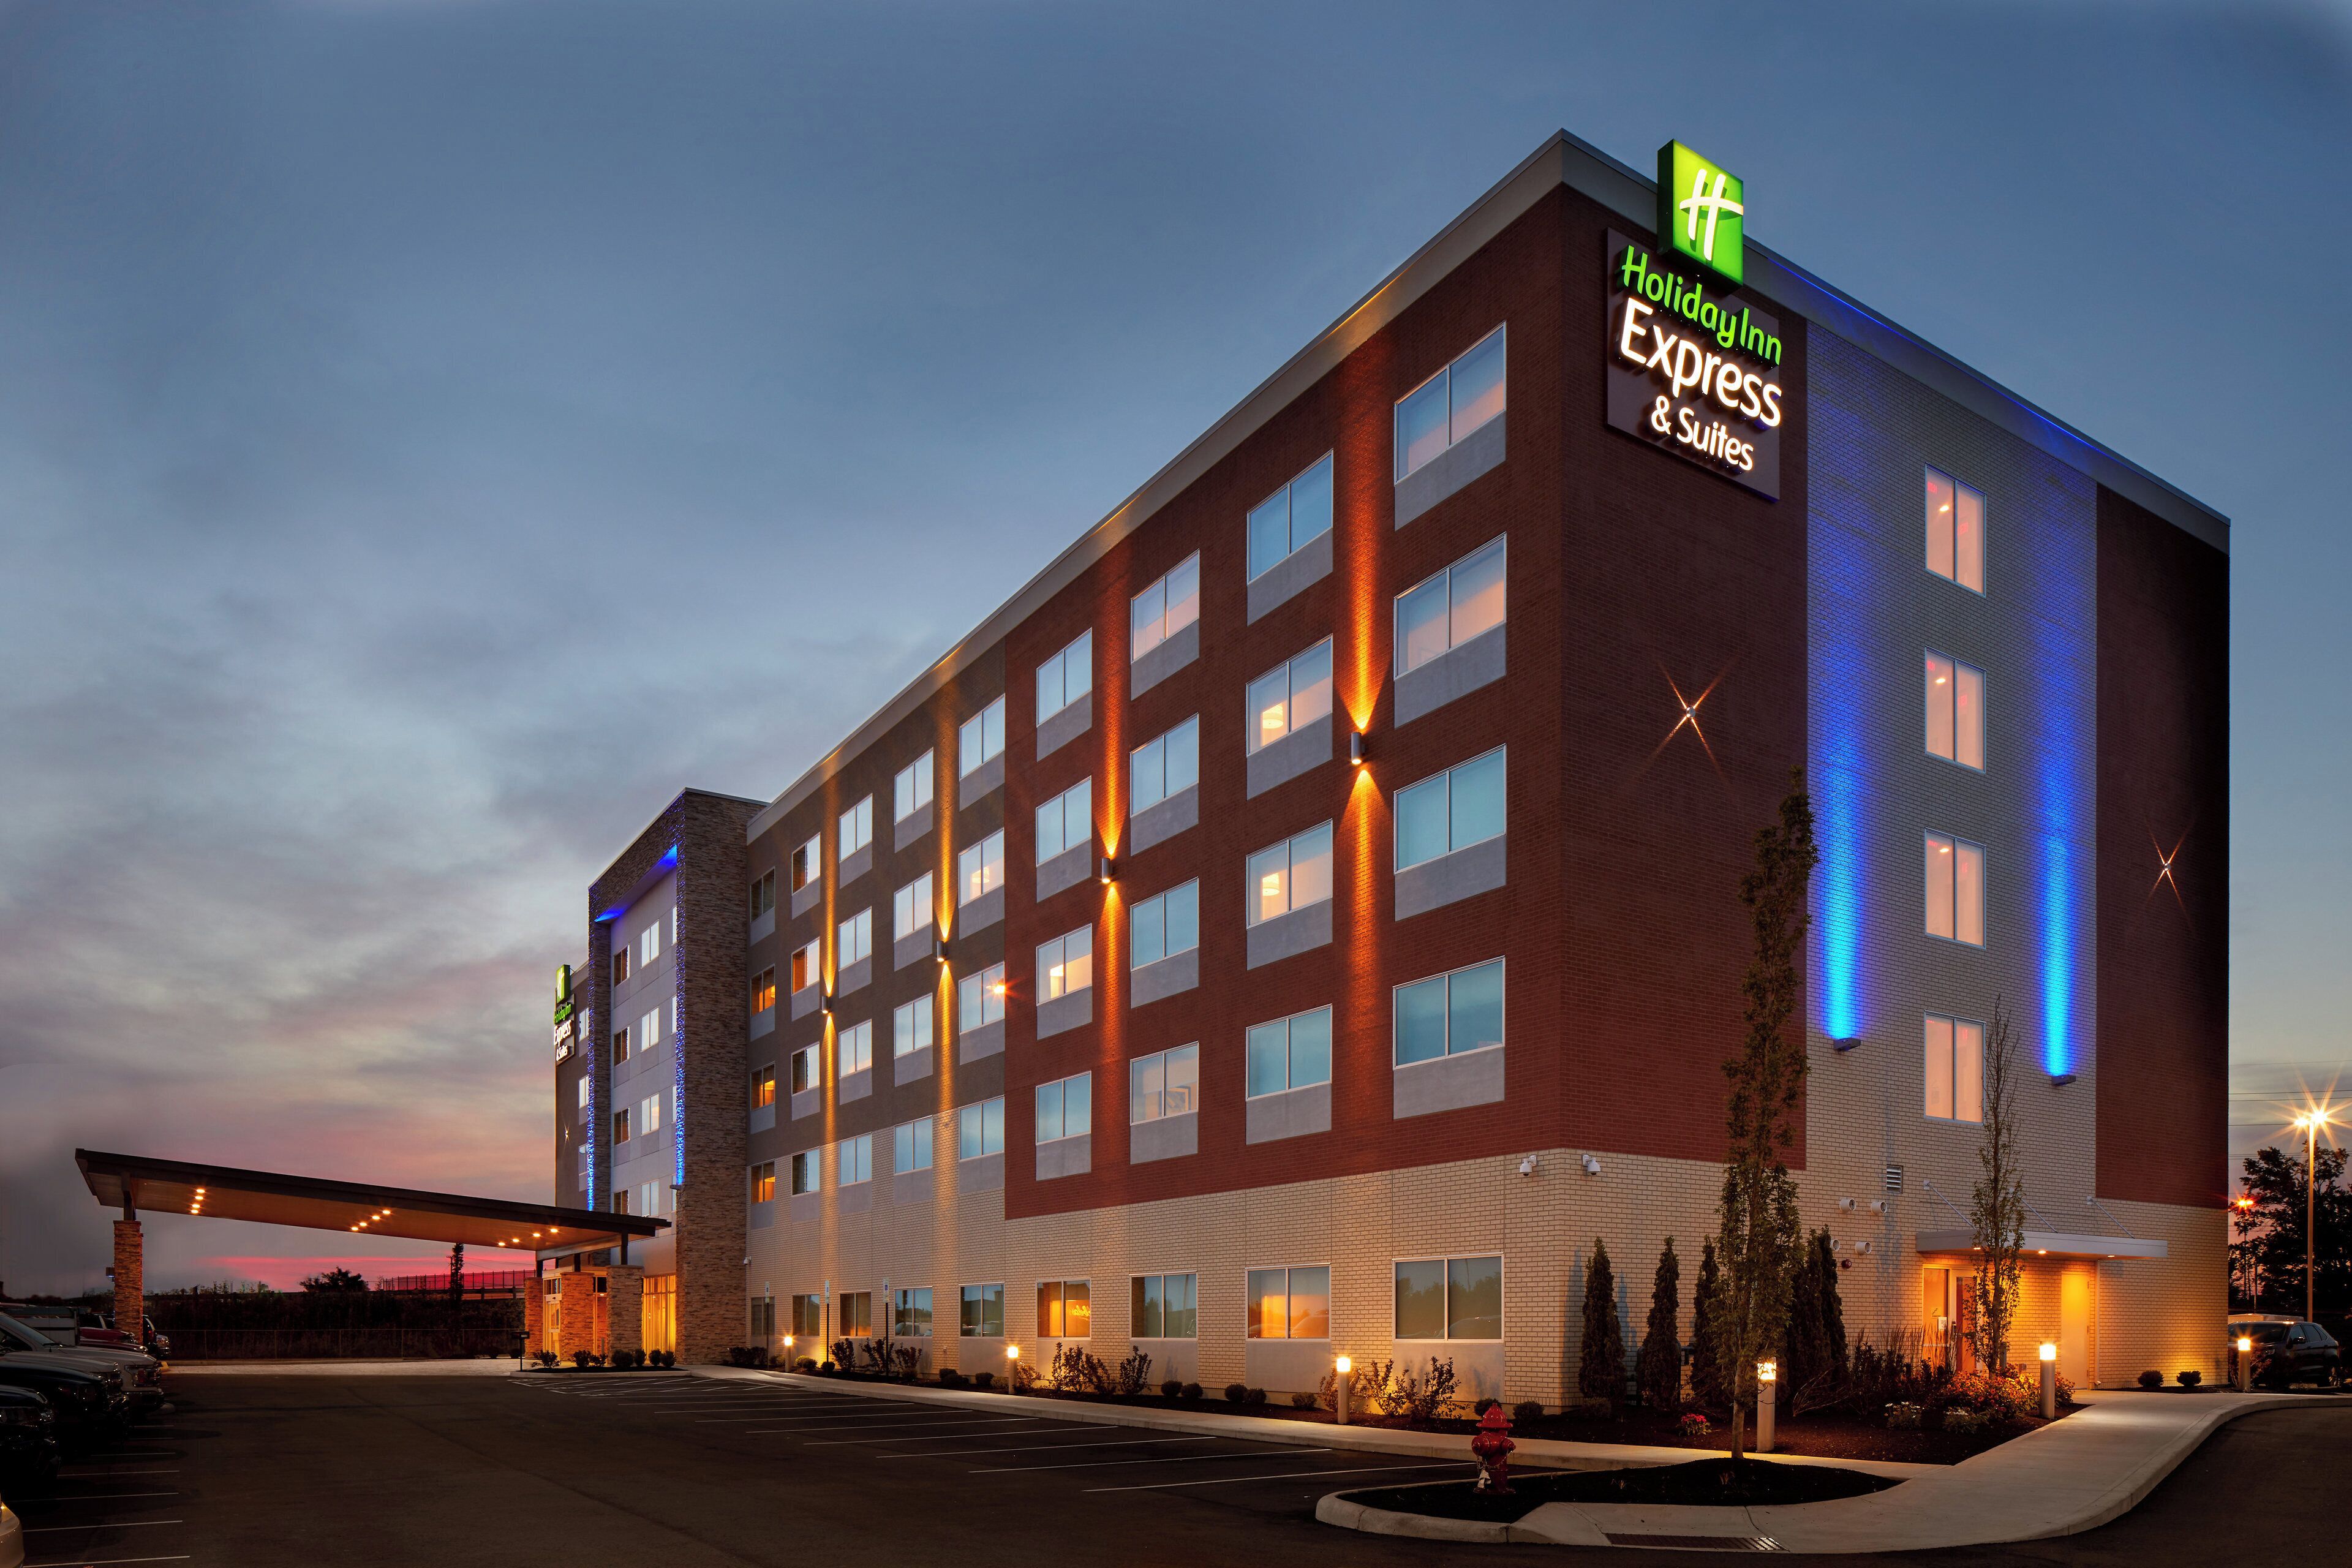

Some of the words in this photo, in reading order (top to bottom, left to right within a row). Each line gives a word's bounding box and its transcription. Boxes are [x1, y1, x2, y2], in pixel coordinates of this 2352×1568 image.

[1620, 297, 1782, 427] Express
[1651, 395, 1672, 435] &
[1677, 407, 1754, 471] Suites
